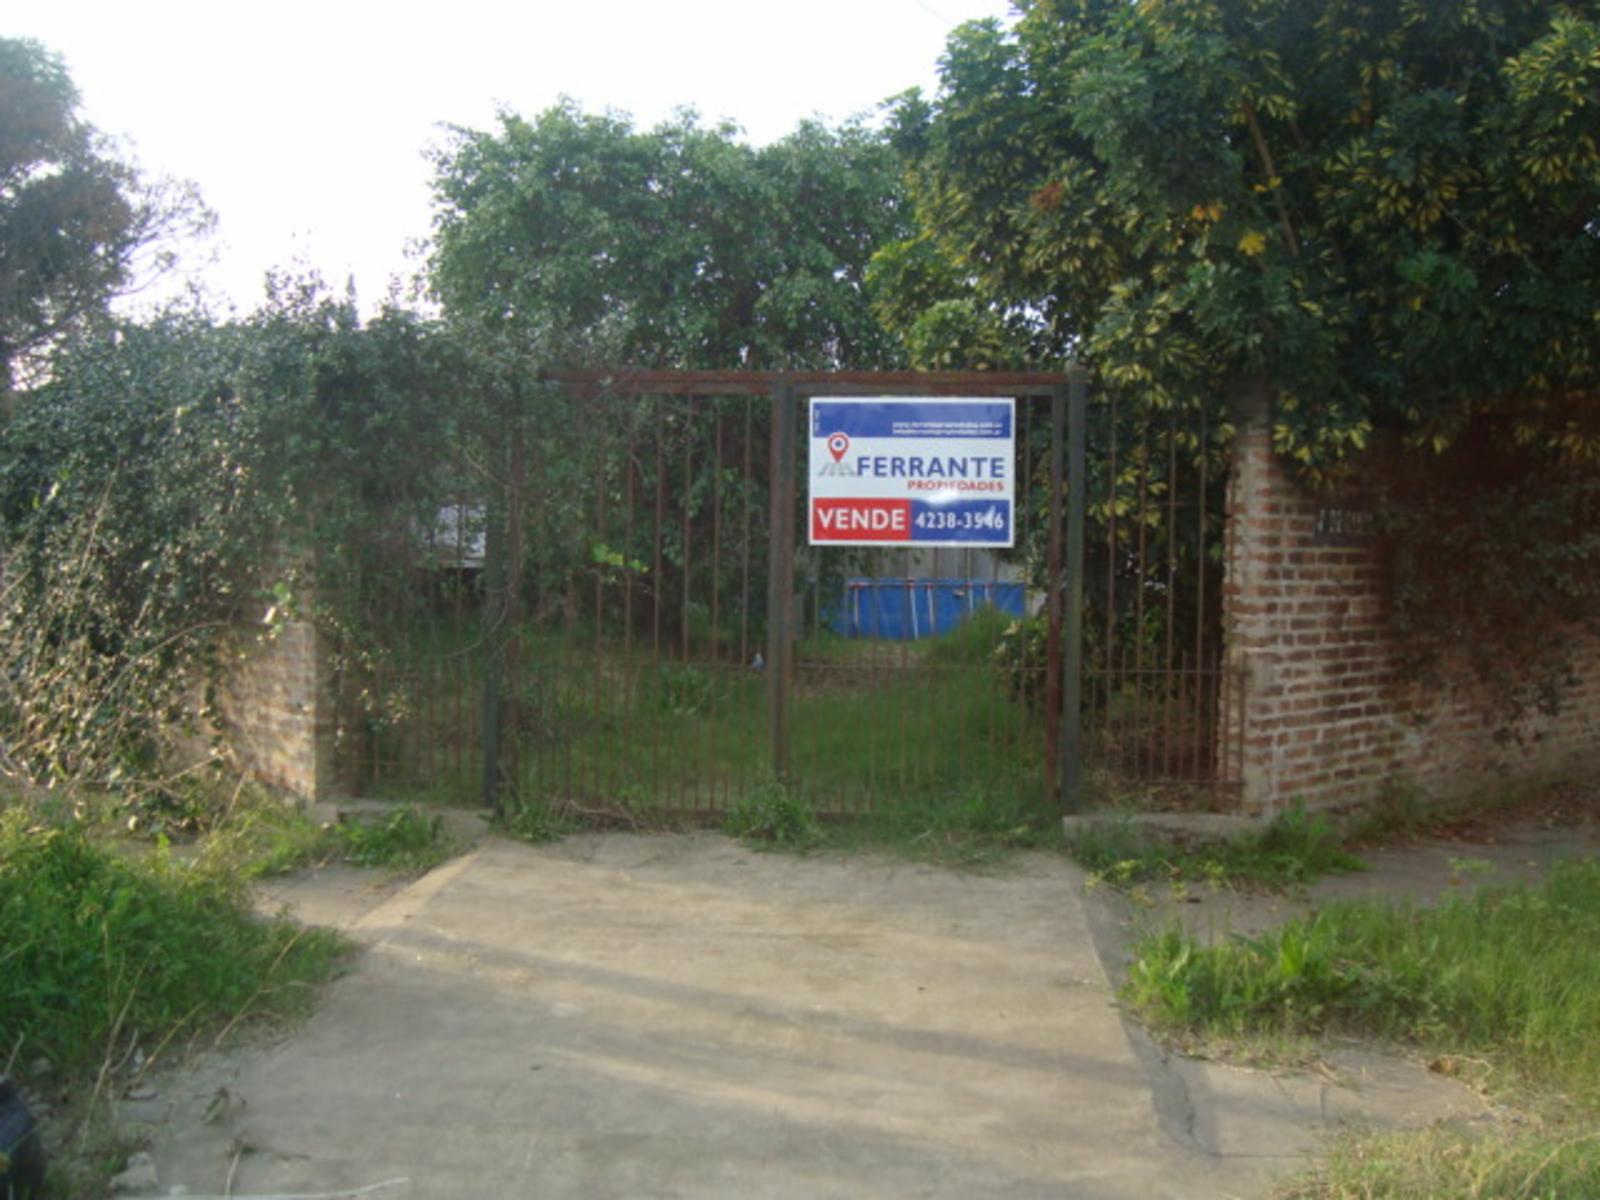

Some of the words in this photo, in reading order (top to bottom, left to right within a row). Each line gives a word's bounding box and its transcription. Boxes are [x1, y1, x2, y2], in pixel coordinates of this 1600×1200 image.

[857, 456, 1005, 478] FERRANTE
[907, 480, 1004, 491] PROPIEDADES
[816, 508, 906, 530] VENDE
